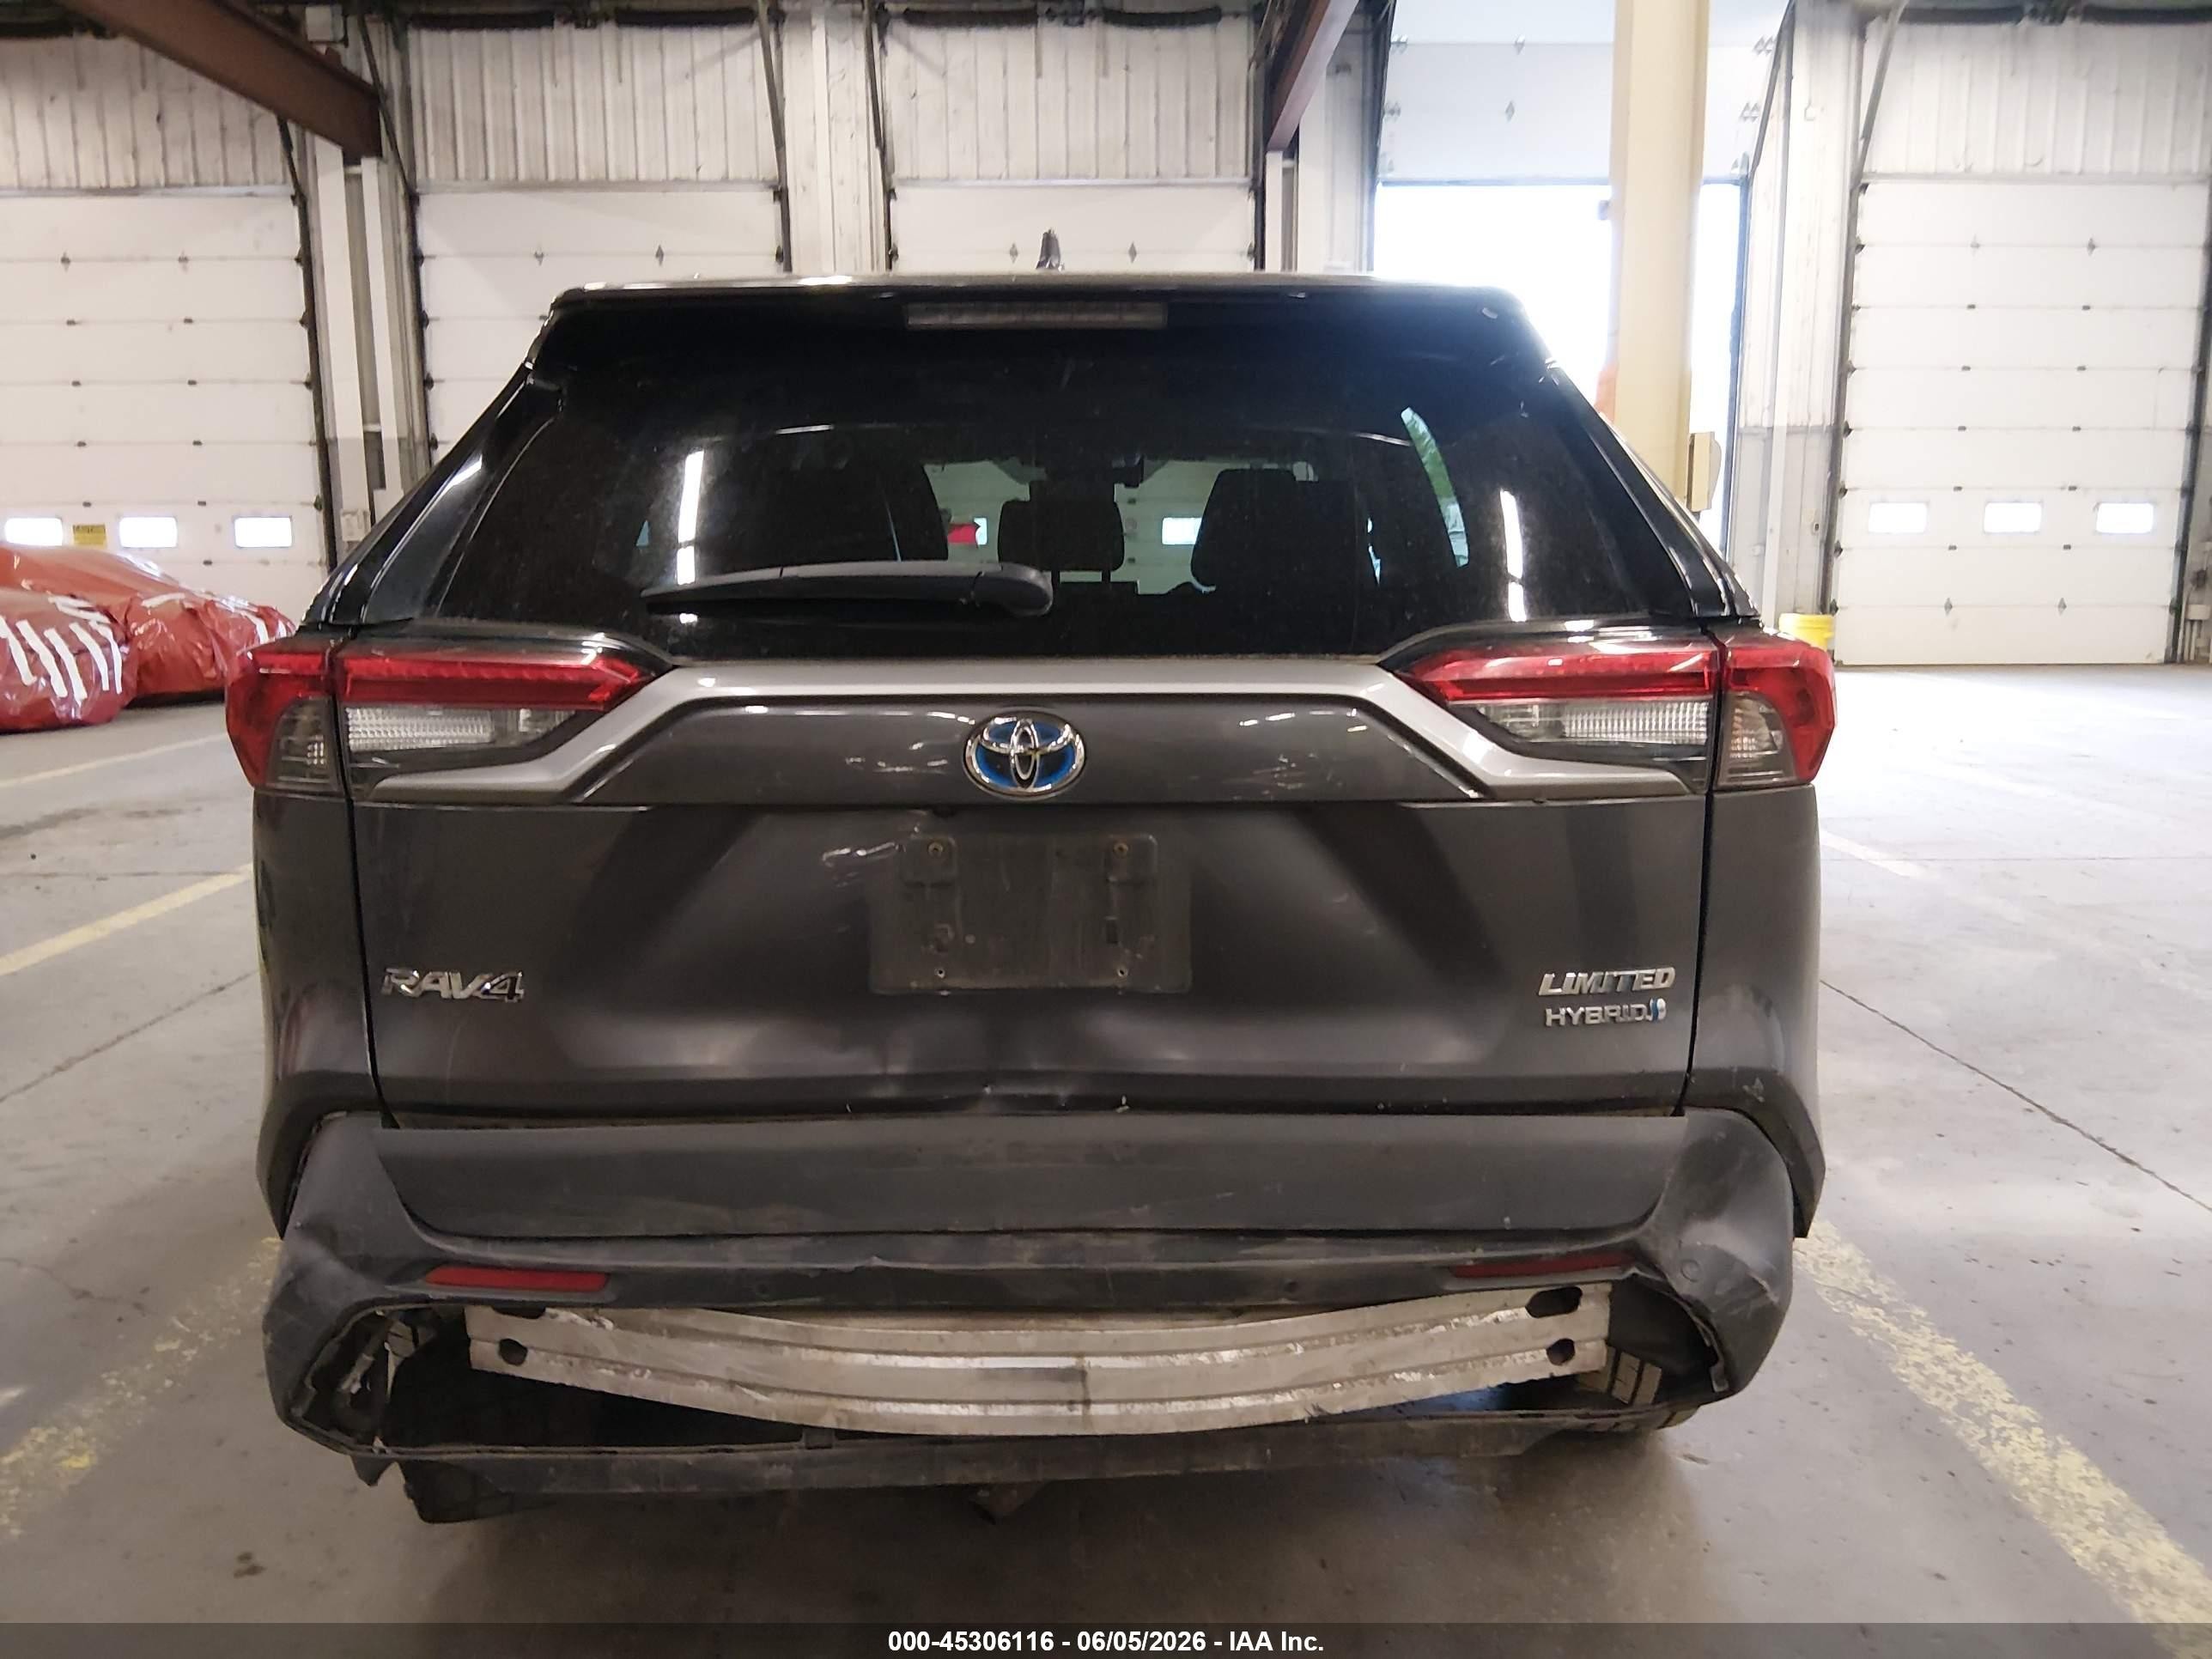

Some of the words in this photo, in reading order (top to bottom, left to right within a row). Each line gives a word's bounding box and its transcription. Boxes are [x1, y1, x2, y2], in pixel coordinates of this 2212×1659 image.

[381, 968, 525, 1003] RAV4
[1538, 967, 1675, 996] LIMITED
[1545, 1003, 1647, 1027] HYBRID
